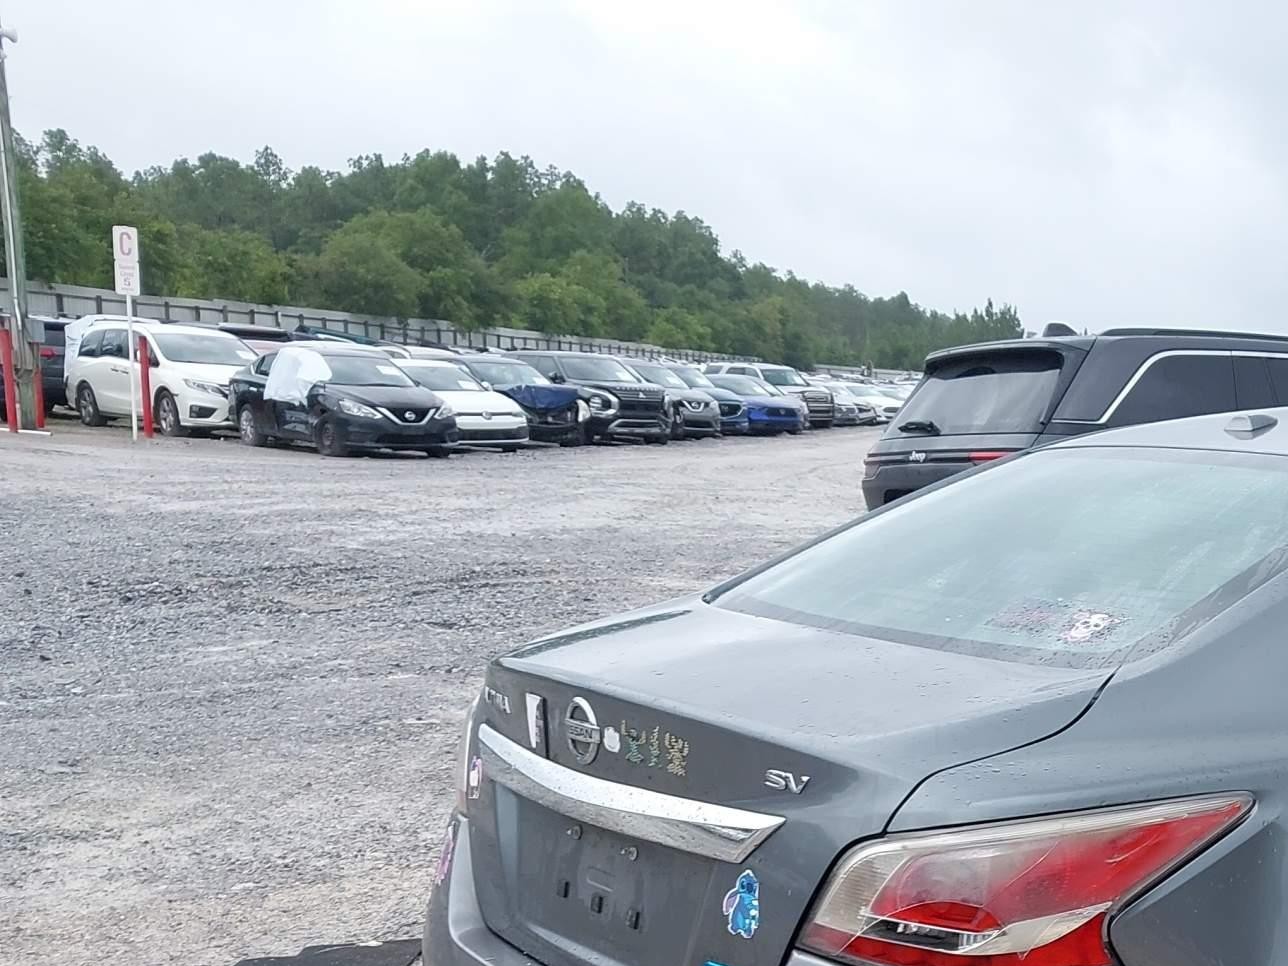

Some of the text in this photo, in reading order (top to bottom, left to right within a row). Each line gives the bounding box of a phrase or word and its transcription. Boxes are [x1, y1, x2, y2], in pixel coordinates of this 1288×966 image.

[119, 231, 132, 256] C
[909, 450, 926, 463] Jeep
[764, 769, 811, 794] SV
